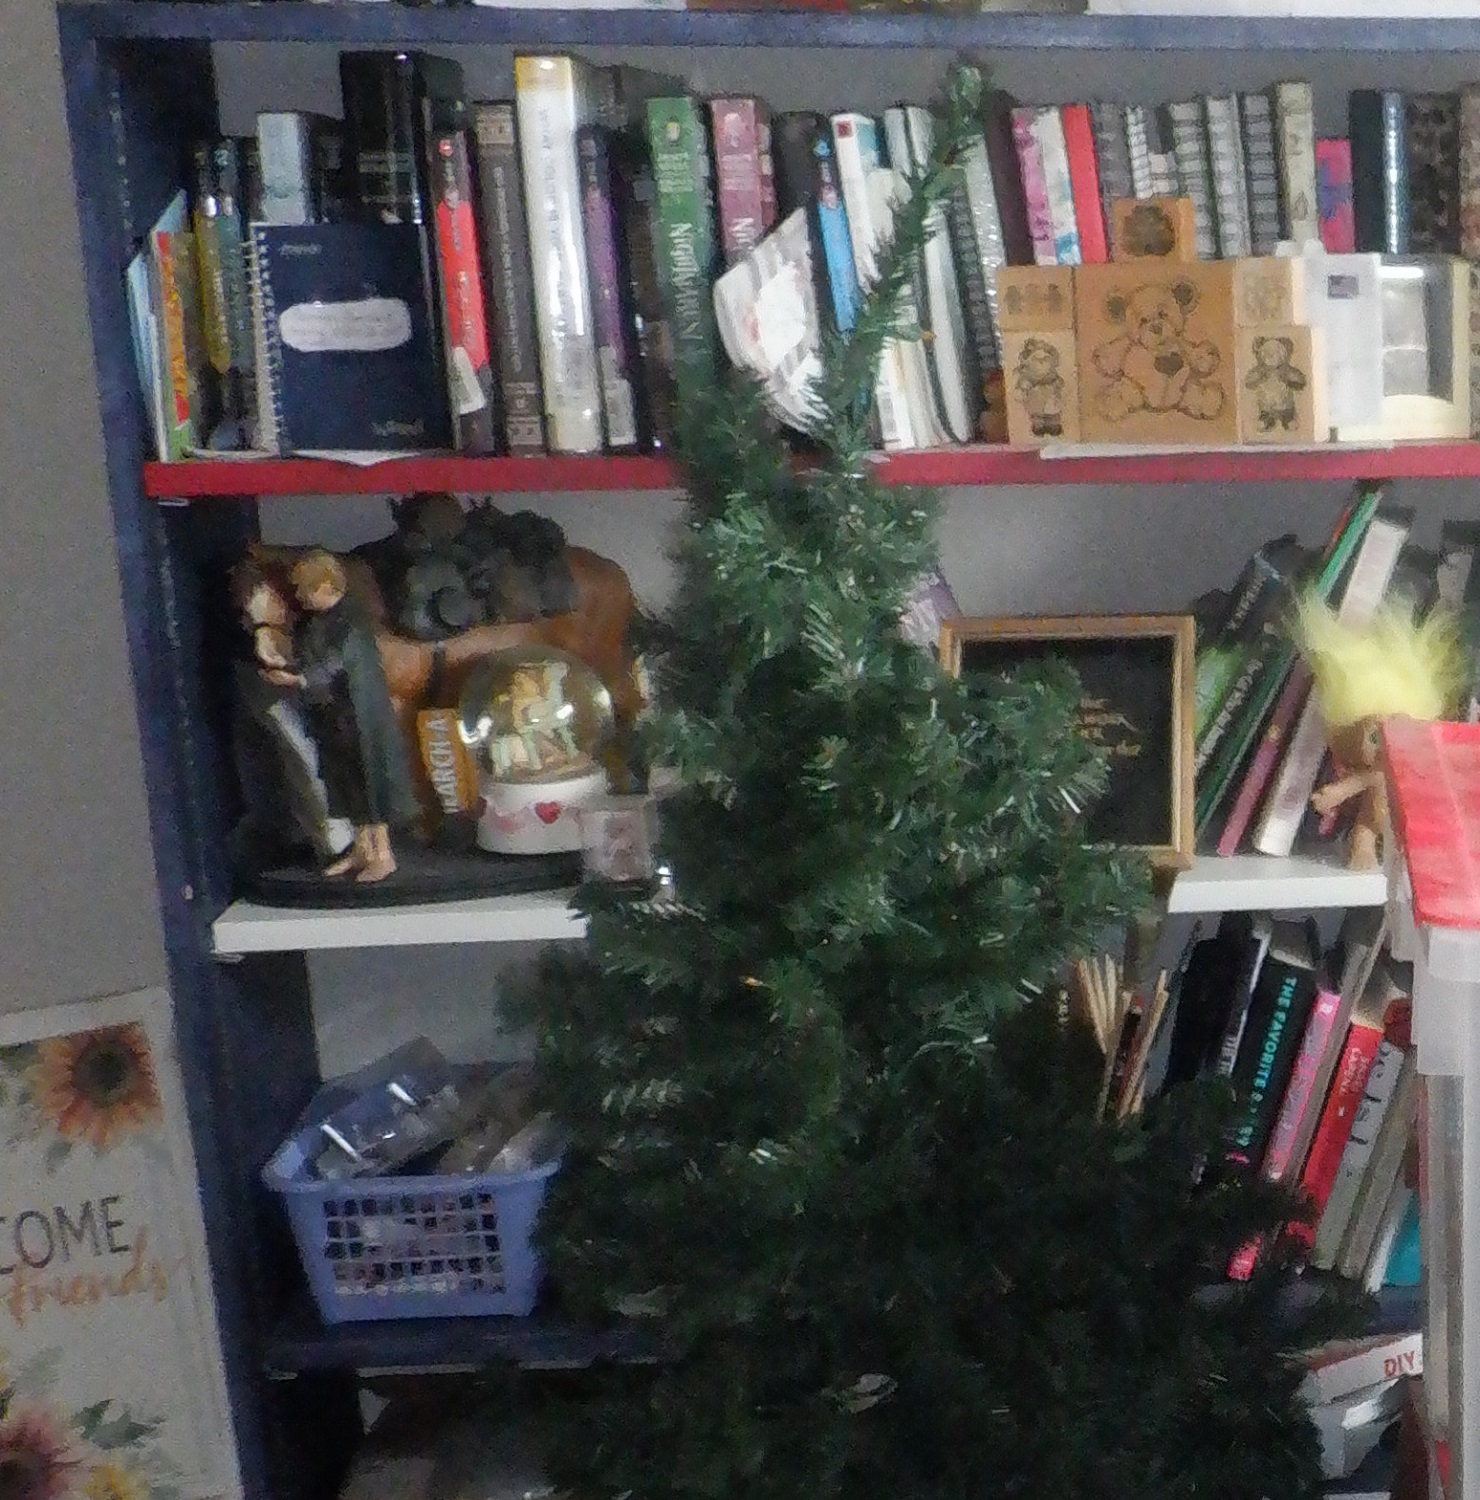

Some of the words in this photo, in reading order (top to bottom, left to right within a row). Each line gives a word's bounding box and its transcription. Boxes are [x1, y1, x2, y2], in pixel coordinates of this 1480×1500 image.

[1276, 977, 1297, 1008] THE
[1254, 1011, 1286, 1089] FAVORITE
[1384, 1350, 1415, 1378] DIY
